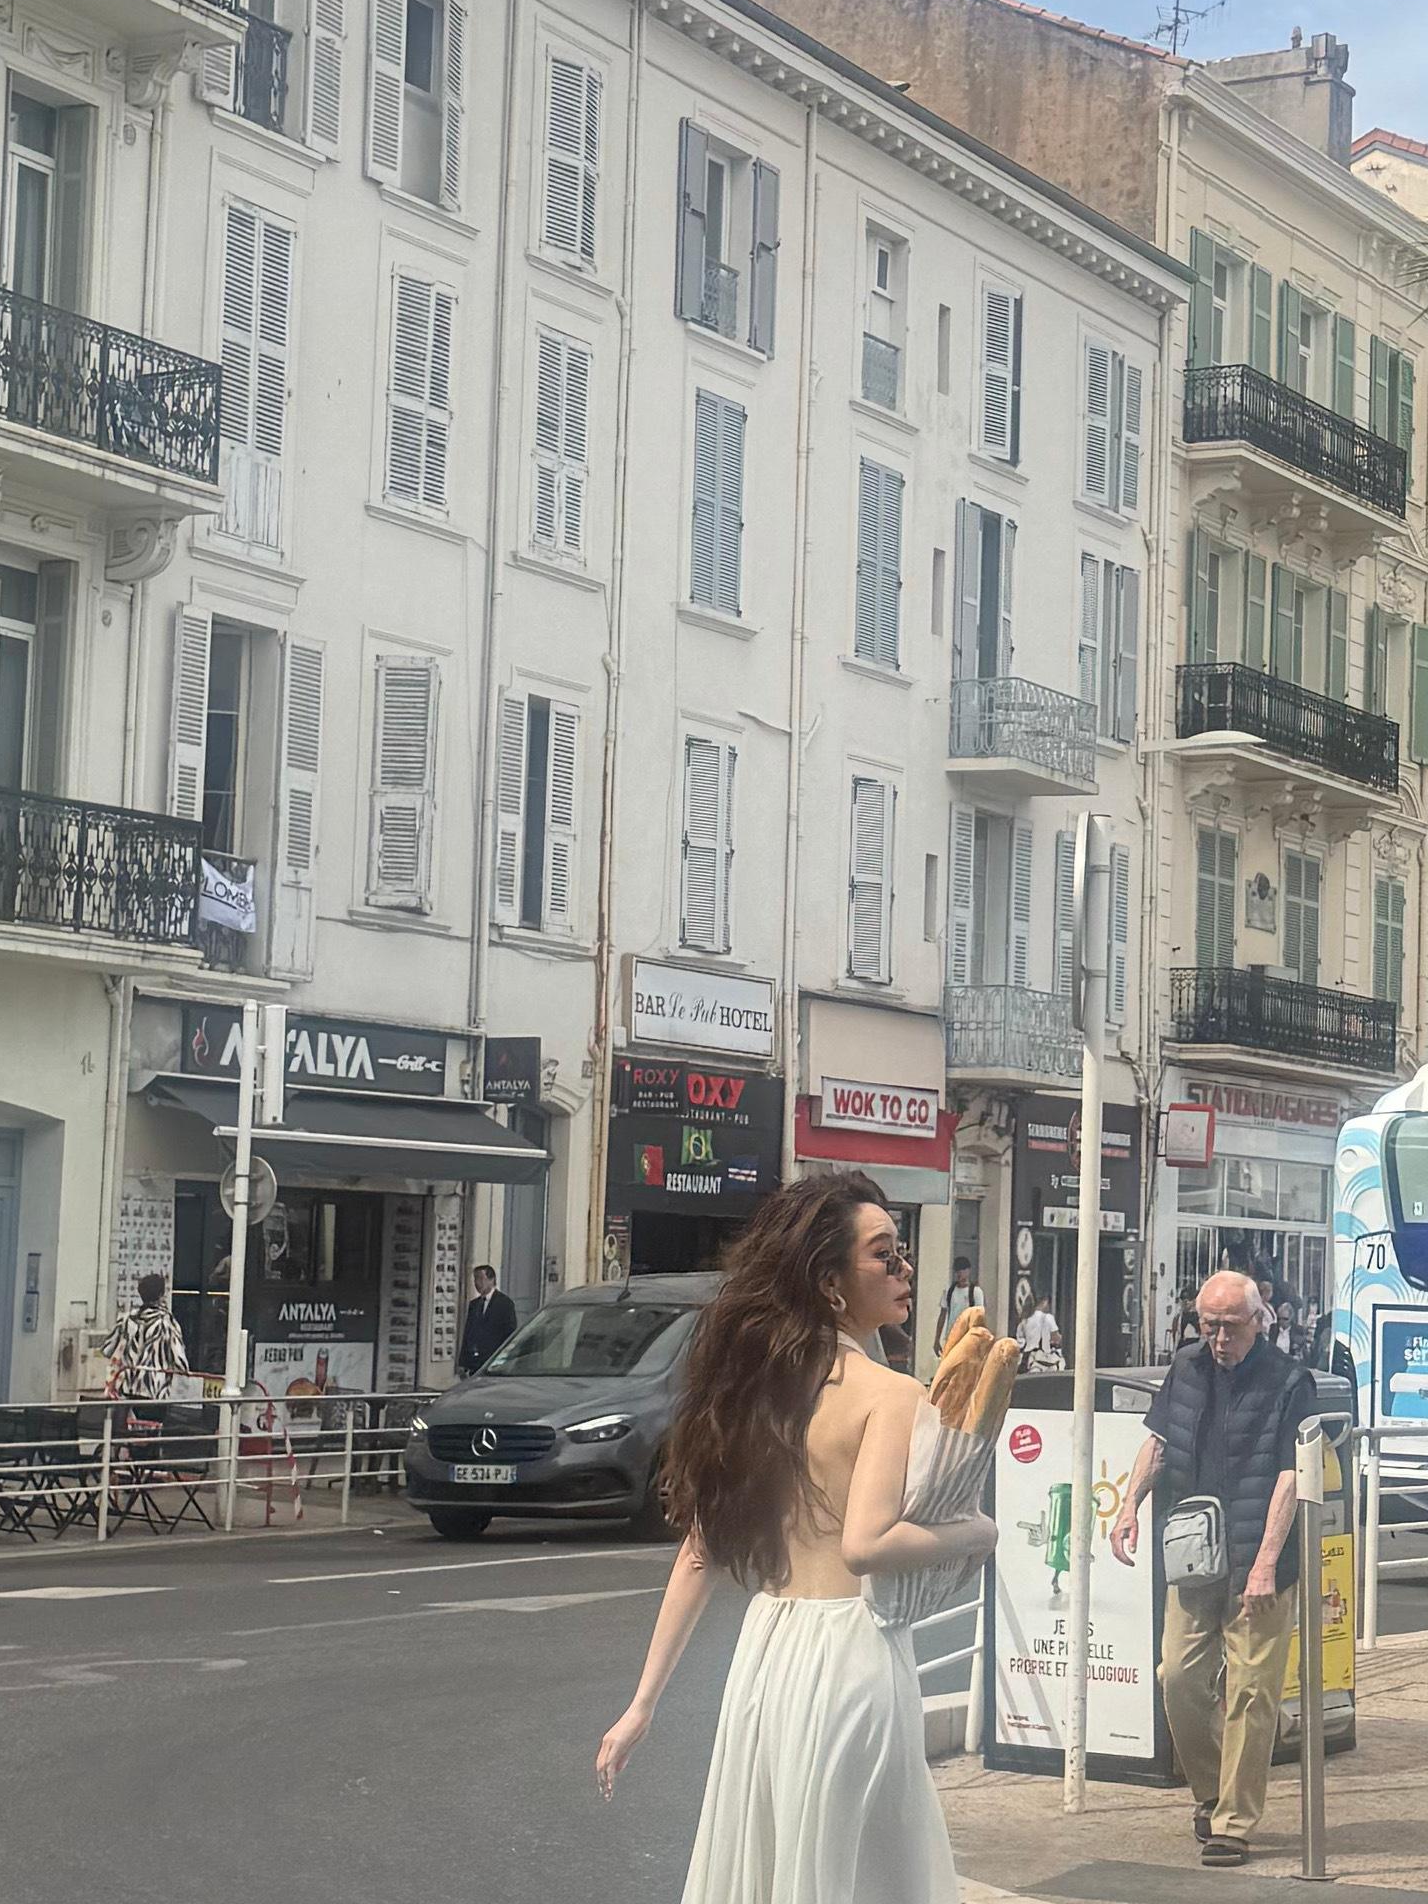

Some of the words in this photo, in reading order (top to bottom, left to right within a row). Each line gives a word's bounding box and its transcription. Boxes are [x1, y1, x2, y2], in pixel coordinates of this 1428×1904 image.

[634, 992, 666, 1017] BAR
[689, 998, 718, 1024] Pub
[719, 1006, 773, 1033] HOTEL
[220, 1022, 375, 1081] AALYA
[485, 1080, 532, 1091] ANTALYA
[633, 1068, 680, 1085] ROXY
[687, 1072, 746, 1110] OXY
[632, 1100, 679, 1109] RESTAURANT
[833, 1088, 876, 1118] WOK
[880, 1094, 902, 1121] TO
[906, 1098, 930, 1124] GO
[665, 1173, 722, 1195] RESTAURANT
[1366, 1243, 1386, 1270] 70
[278, 1303, 337, 1322] ANTALYA
[1053, 1619, 1066, 1635] JE
[1033, 1638, 1055, 1656] UNE
[1058, 1641, 1114, 1661] PELLE
[1010, 1658, 1052, 1677] PROPRE
[1056, 1662, 1069, 1678] ET
[1086, 1664, 1139, 1684] OLOGIQUE
